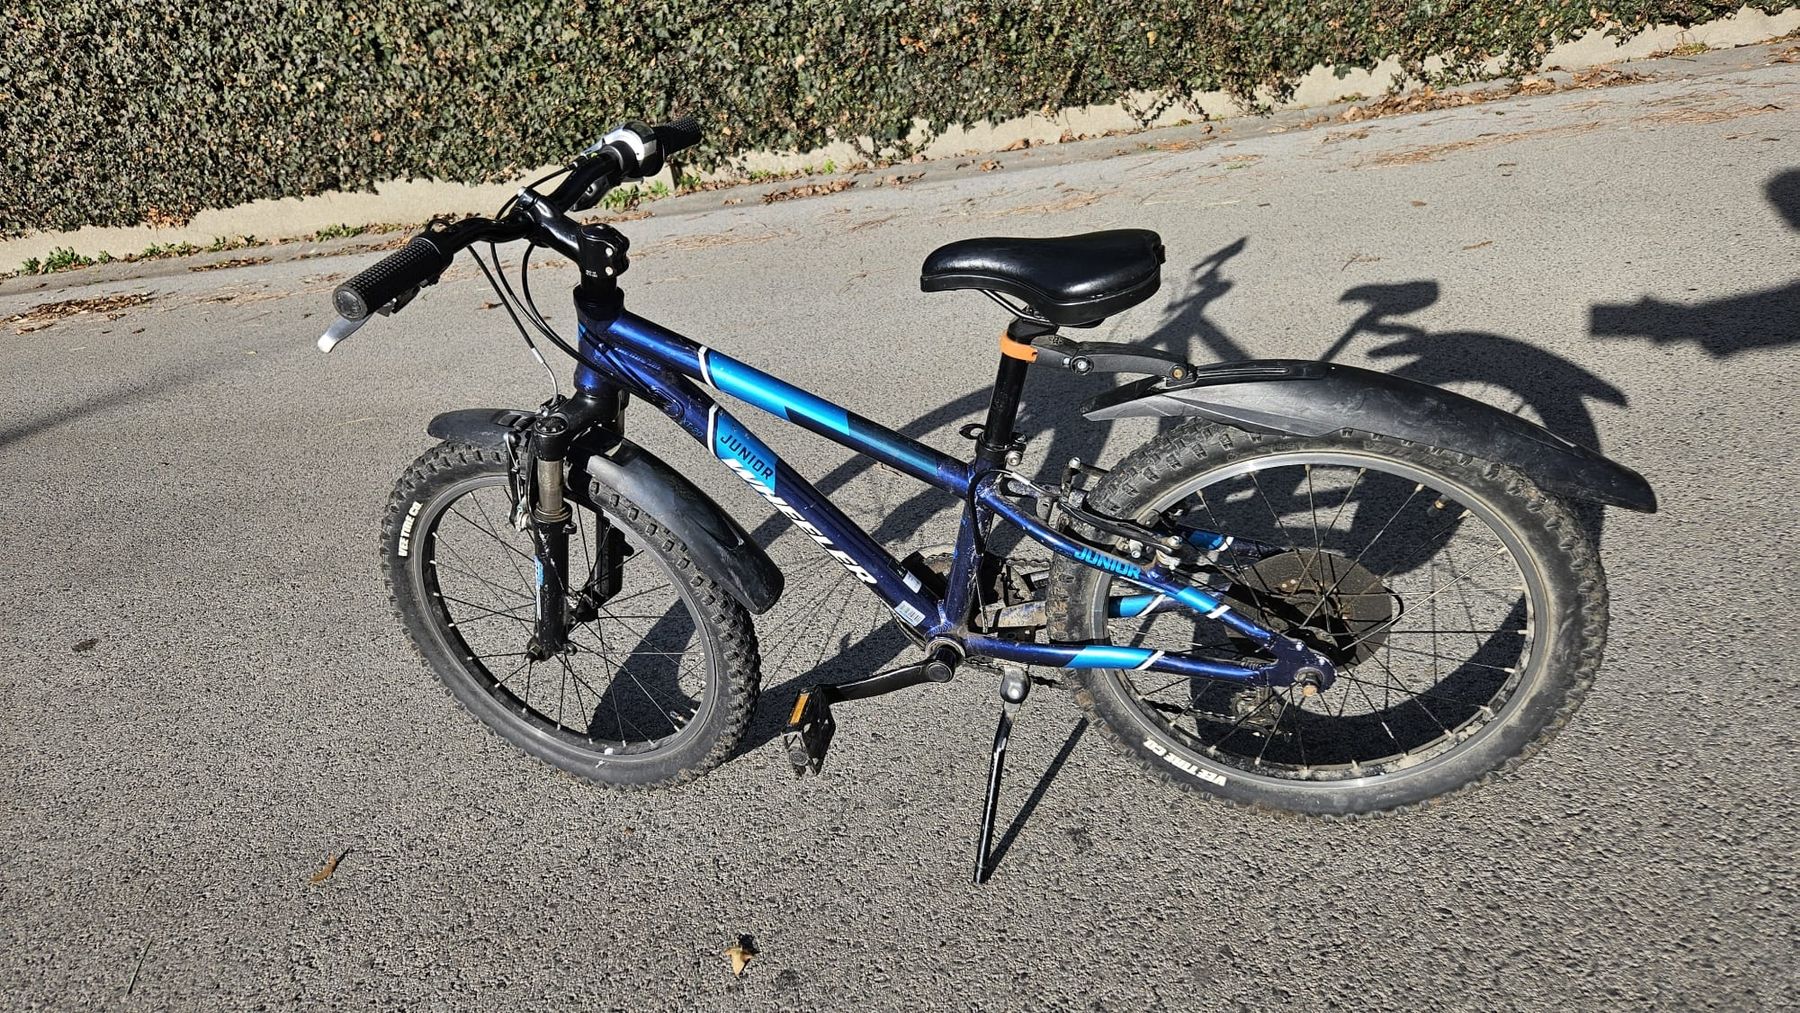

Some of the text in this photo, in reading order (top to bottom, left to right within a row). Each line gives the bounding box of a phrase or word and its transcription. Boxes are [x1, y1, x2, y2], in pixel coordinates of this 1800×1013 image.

[720, 434, 774, 480] JUNIOR
[400, 514, 416, 538] TIRE
[720, 458, 878, 585] WHEELER
[398, 536, 409, 557] VEE
[1074, 547, 1141, 580] JUNIOR
[1163, 752, 1199, 776] TIRE
[1196, 768, 1227, 787] VEE
